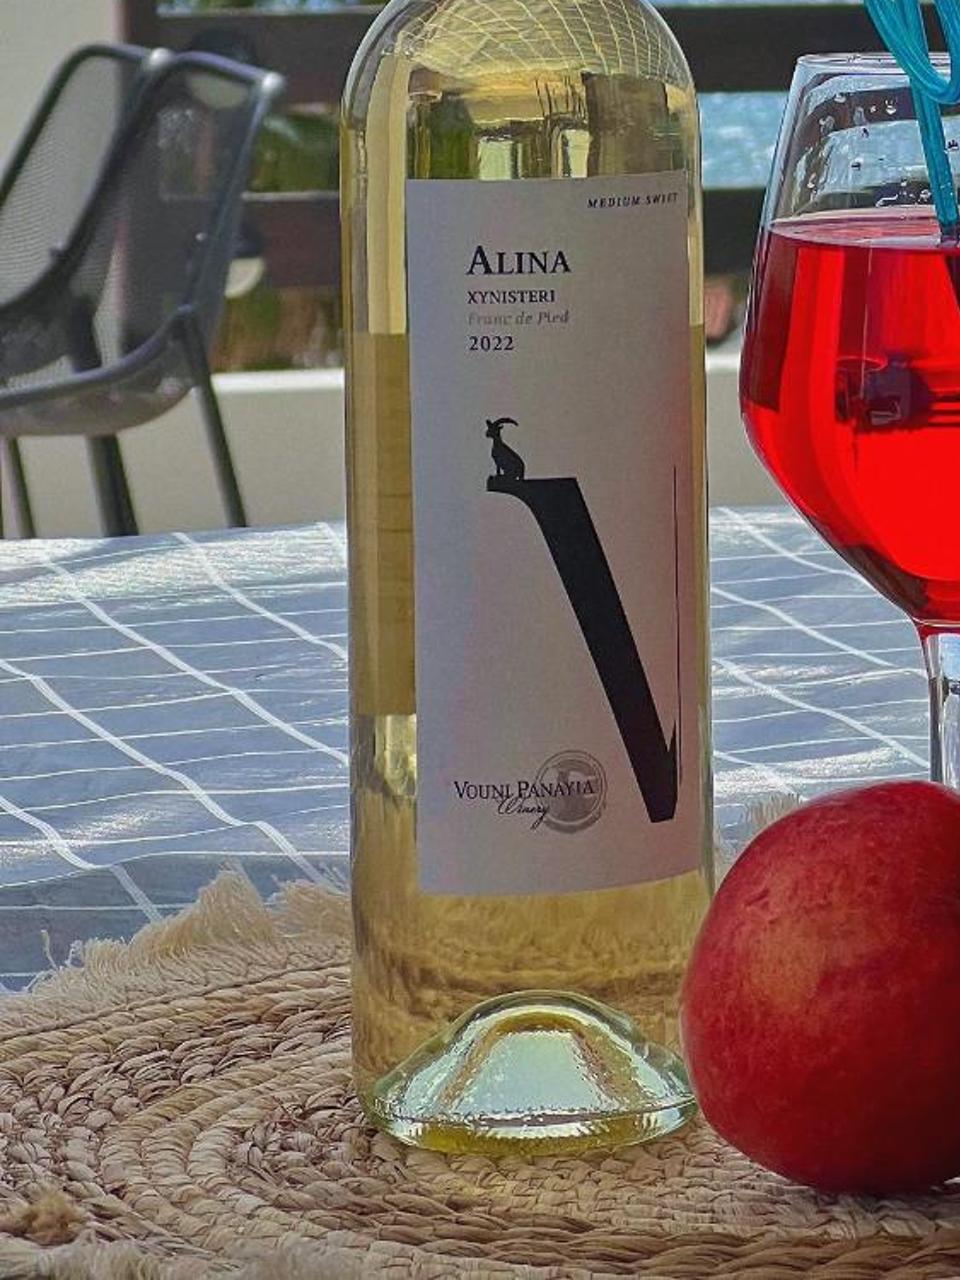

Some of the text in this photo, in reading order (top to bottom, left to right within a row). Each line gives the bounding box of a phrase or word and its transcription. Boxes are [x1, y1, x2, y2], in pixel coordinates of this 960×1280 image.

[587, 195, 640, 208] MEDIUM
[466, 245, 571, 275] ALINA
[468, 290, 555, 304] XYNISTERI
[515, 311, 533, 325] de
[469, 336, 514, 352] 2022
[454, 780, 595, 799] VOUNI PANAYIA
